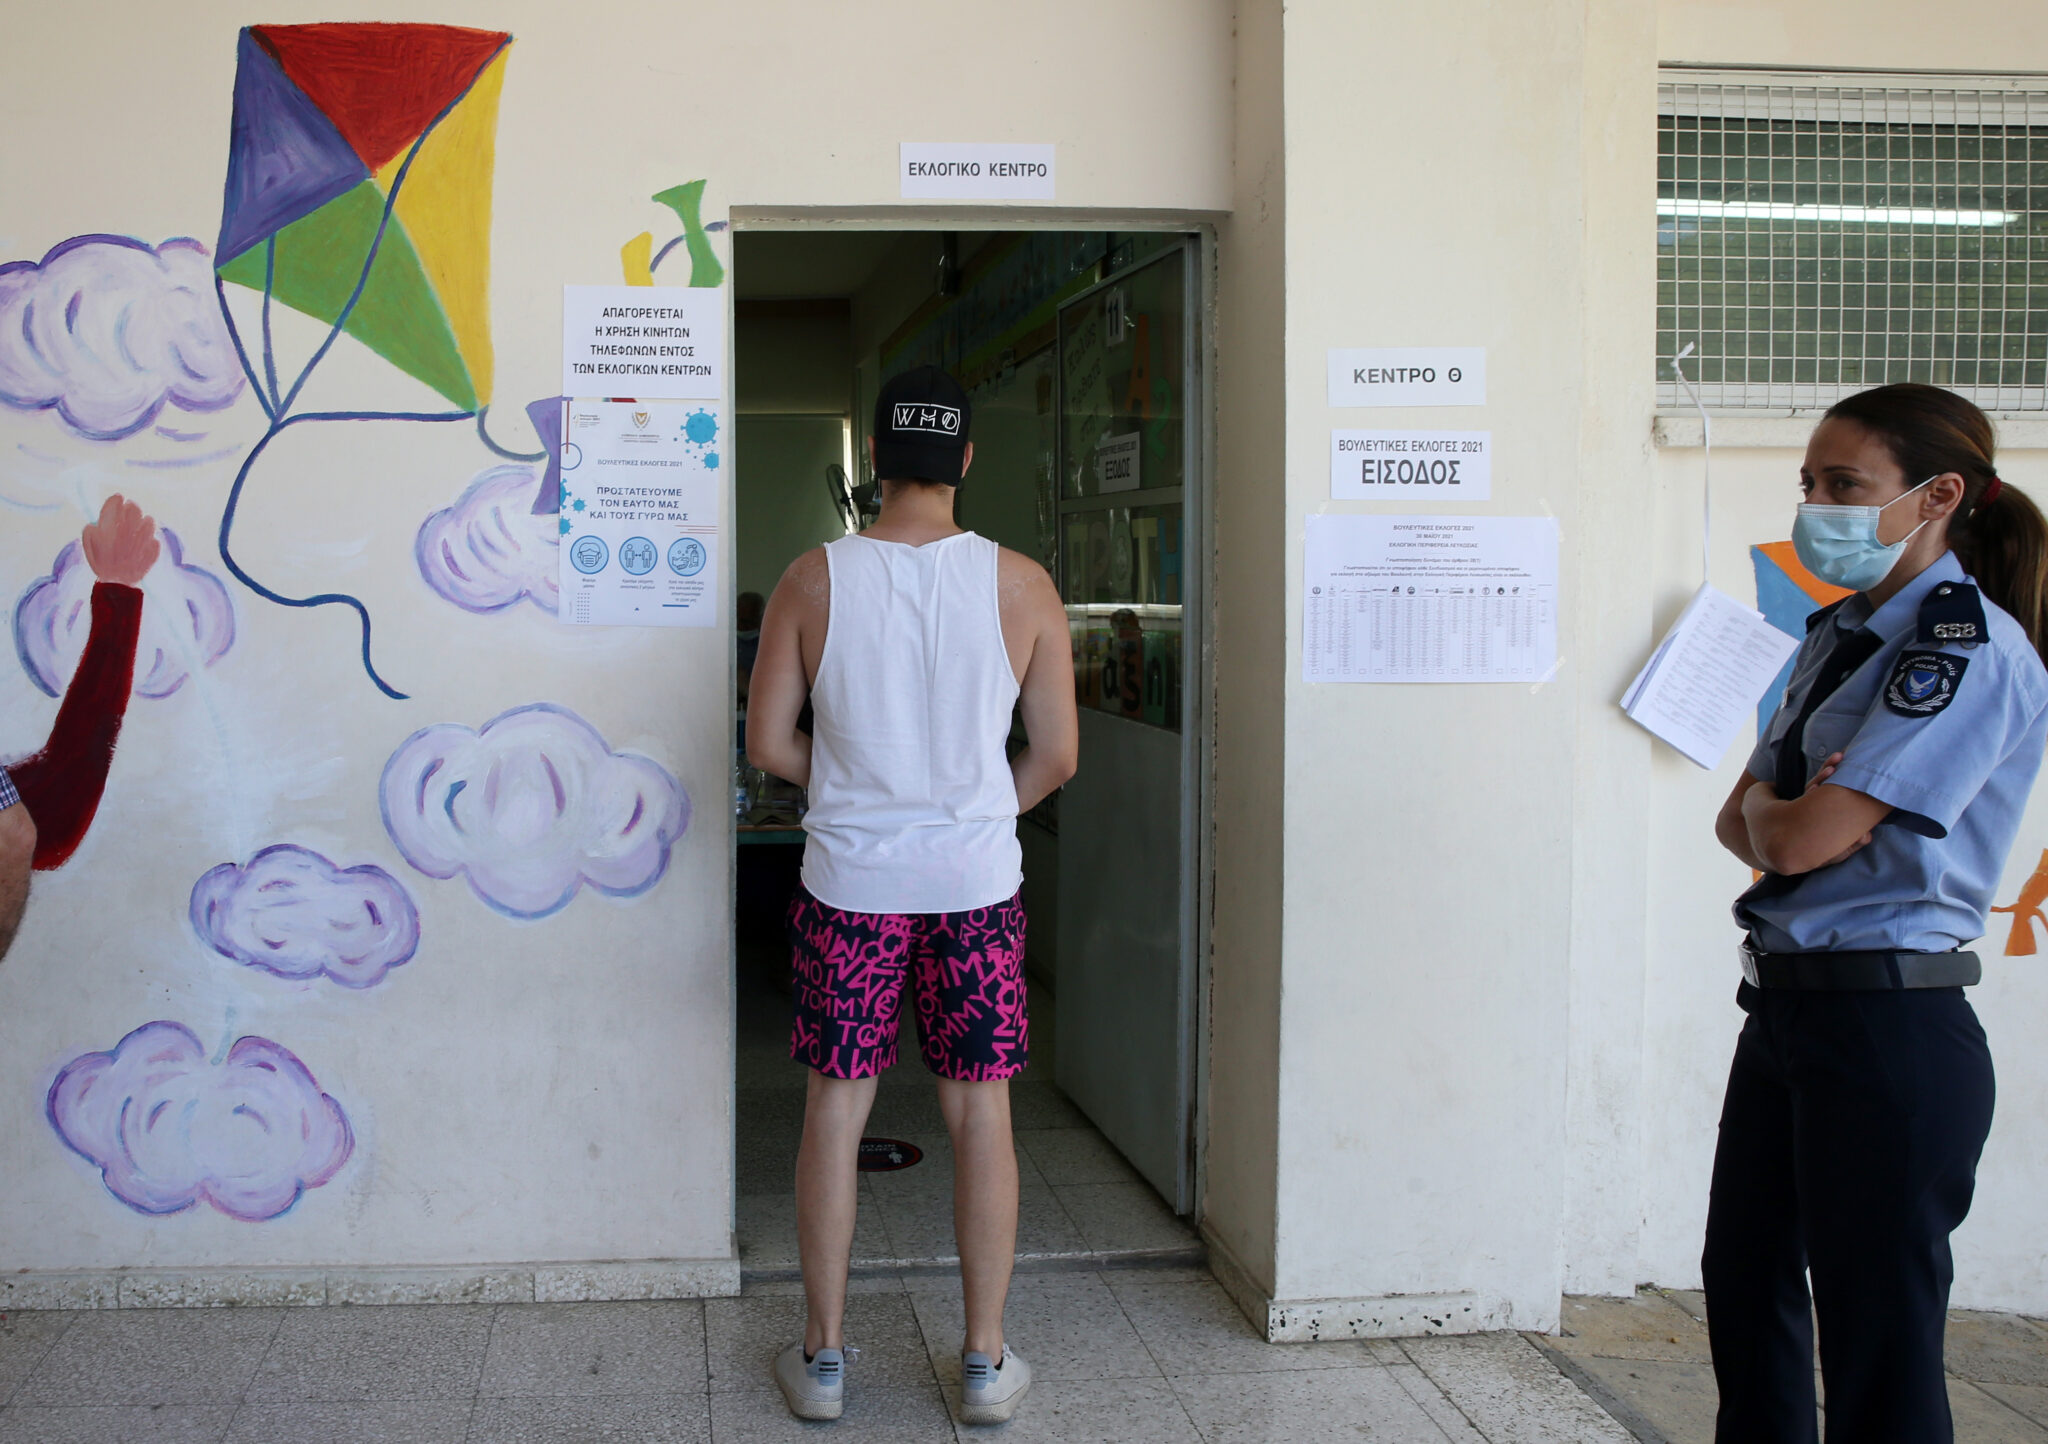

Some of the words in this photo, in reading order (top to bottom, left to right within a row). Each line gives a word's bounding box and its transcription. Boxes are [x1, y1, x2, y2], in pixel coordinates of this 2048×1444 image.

[908, 162, 981, 177] ΕΚΛΟΓΙΚΟ
[989, 162, 1047, 177] ΚΕΝΤΡΟ
[602, 307, 683, 319] ΑΠΑΓΟΡΕΥΕΤΑΙ
[595, 326, 603, 337] Η
[605, 326, 640, 338] ΧΡΗΣΗ
[643, 327, 690, 338] ΚΙΝΗΤΩΝ
[590, 344, 657, 356] ΤΗΛΕΦΩΝΩΝ
[660, 346, 695, 357] ΕΝΤΟΣ
[573, 363, 595, 374] ΤΩΝ
[597, 363, 658, 375] ΕΚΛΟΓΙΚΩΝ
[661, 364, 712, 376] ΚΕΝΤΡΩΝ
[1353, 367, 1436, 384] ΚΕΝΤΡΟ
[1447, 367, 1463, 383] Θ
[1338, 439, 1408, 452] ΒΟΥΛΕΥΤΙΚΕΣ
[1411, 440, 1458, 453] ΕΚΛΟΓΕΣ
[1461, 440, 1484, 453] 2021
[1361, 459, 1461, 485] ΕΙΣΟΔΟΣ
[596, 486, 683, 497] ΠΡΟΣΤΑΤΕΥΟΥΜΕ
[600, 498, 621, 508] ΤΟΝ
[623, 499, 656, 509] ΕΑΥΤΟ
[658, 500, 680, 509] ΜΑΣ
[589, 510, 607, 520] ΚΑΙ
[610, 511, 636, 521] ΤΟΥΣ
[638, 511, 665, 521] ΓΥΡΩ
[667, 512, 689, 522] ΜΑΣ
